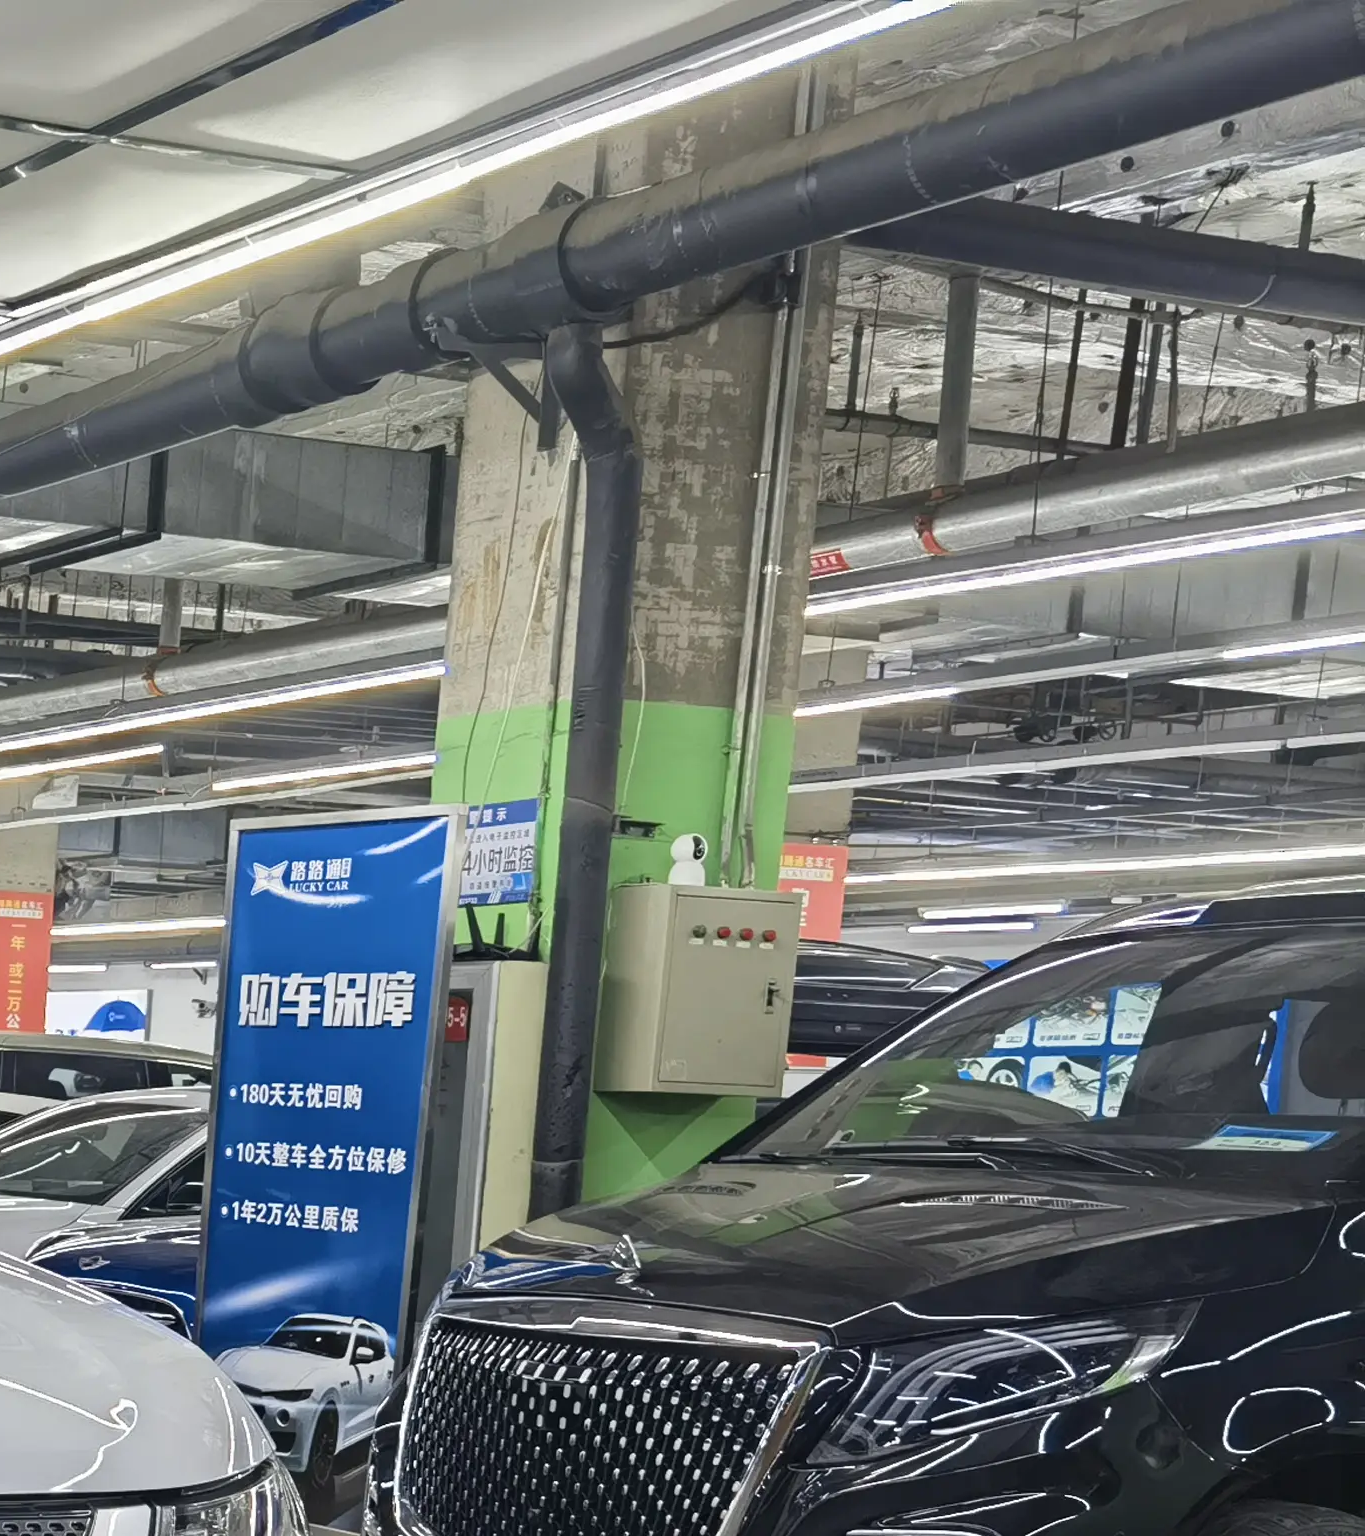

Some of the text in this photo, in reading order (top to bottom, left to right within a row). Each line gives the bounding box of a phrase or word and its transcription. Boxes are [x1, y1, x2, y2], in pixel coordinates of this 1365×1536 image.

[469, 807, 508, 825] 提示
[290, 858, 341, 881] 路路通
[289, 881, 349, 892] LUCKY CAR
[238, 971, 417, 1028] 购车保障
[240, 1083, 363, 1110] 180天无忧回购
[236, 1142, 407, 1175] 10天整车全方位保修
[232, 1200, 359, 1233] 1年2万公里质保
